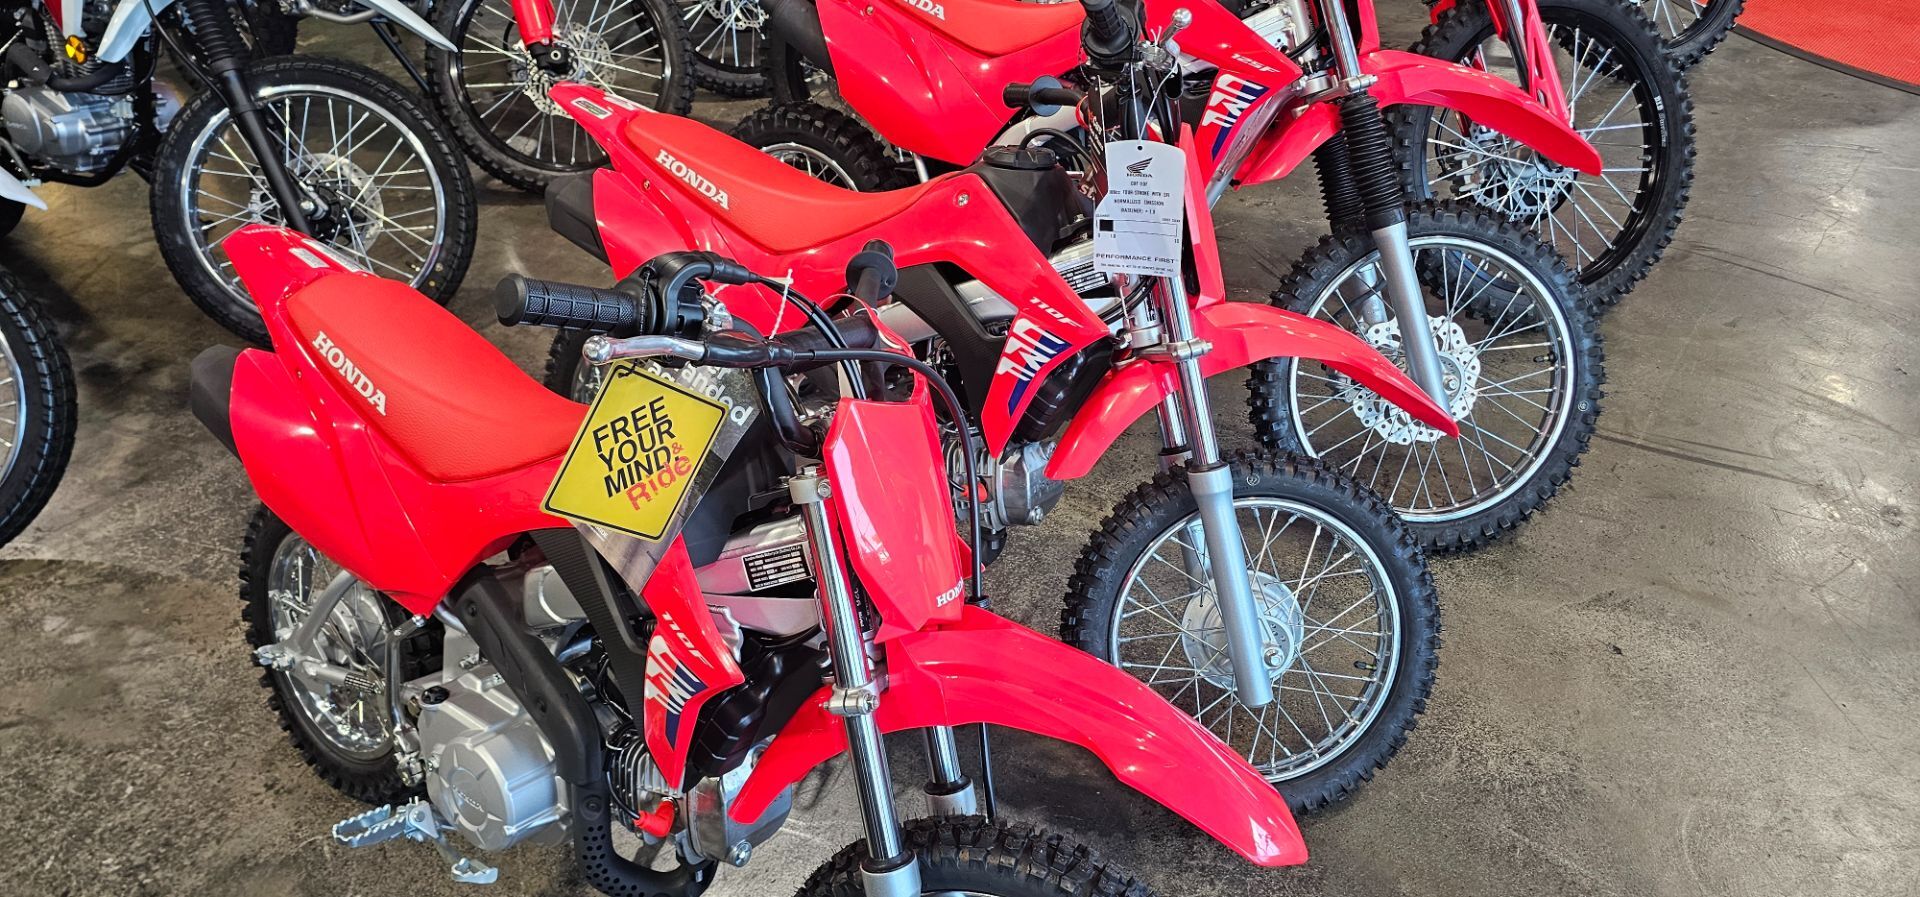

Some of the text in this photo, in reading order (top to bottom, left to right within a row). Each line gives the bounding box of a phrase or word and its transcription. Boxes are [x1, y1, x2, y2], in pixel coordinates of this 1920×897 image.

[1231, 53, 1280, 73] 125F
[655, 148, 729, 210] HONDA
[1095, 253, 1152, 261] PERFORMANCE
[1029, 296, 1083, 328] 110F
[312, 330, 387, 417] HONDA
[592, 395, 669, 453] FREE
[598, 419, 677, 472] YOUR
[626, 442, 693, 511] & Ride
[936, 576, 964, 608] HON
[661, 610, 715, 670] 110F
